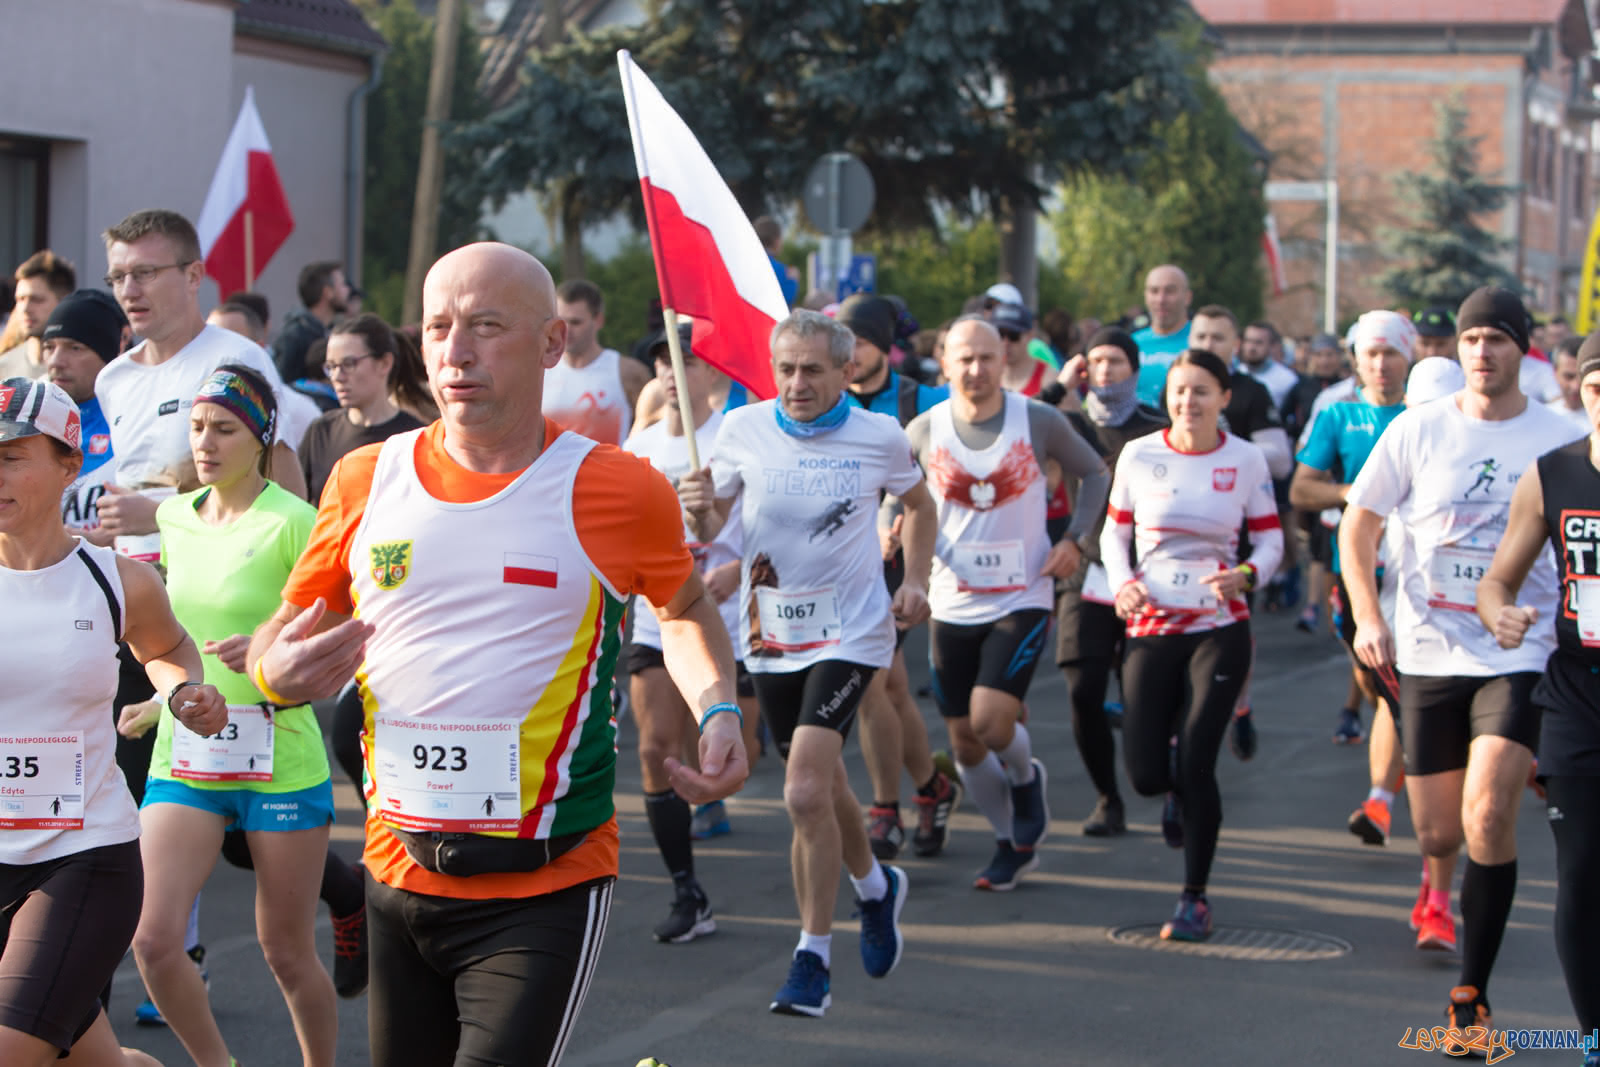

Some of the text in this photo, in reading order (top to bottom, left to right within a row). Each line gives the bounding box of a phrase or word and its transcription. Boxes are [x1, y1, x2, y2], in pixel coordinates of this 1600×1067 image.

[798, 456, 861, 471] KOŚCIAN
[763, 467, 862, 497] TEAM
[973, 552, 1002, 568] 433
[1567, 540, 1600, 575] T
[1171, 573, 1190, 587] 27
[1452, 563, 1487, 582] 143
[776, 602, 816, 620] 1067
[816, 670, 863, 721] Kalenji
[201, 723, 239, 741] 13
[420, 722, 438, 731] BIEG
[0, 756, 40, 778] 35
[412, 744, 468, 772] 923
[510, 751, 518, 782] STREFA
[75, 759, 83, 786] STREFA
[1, 786, 25, 796] Edyta
